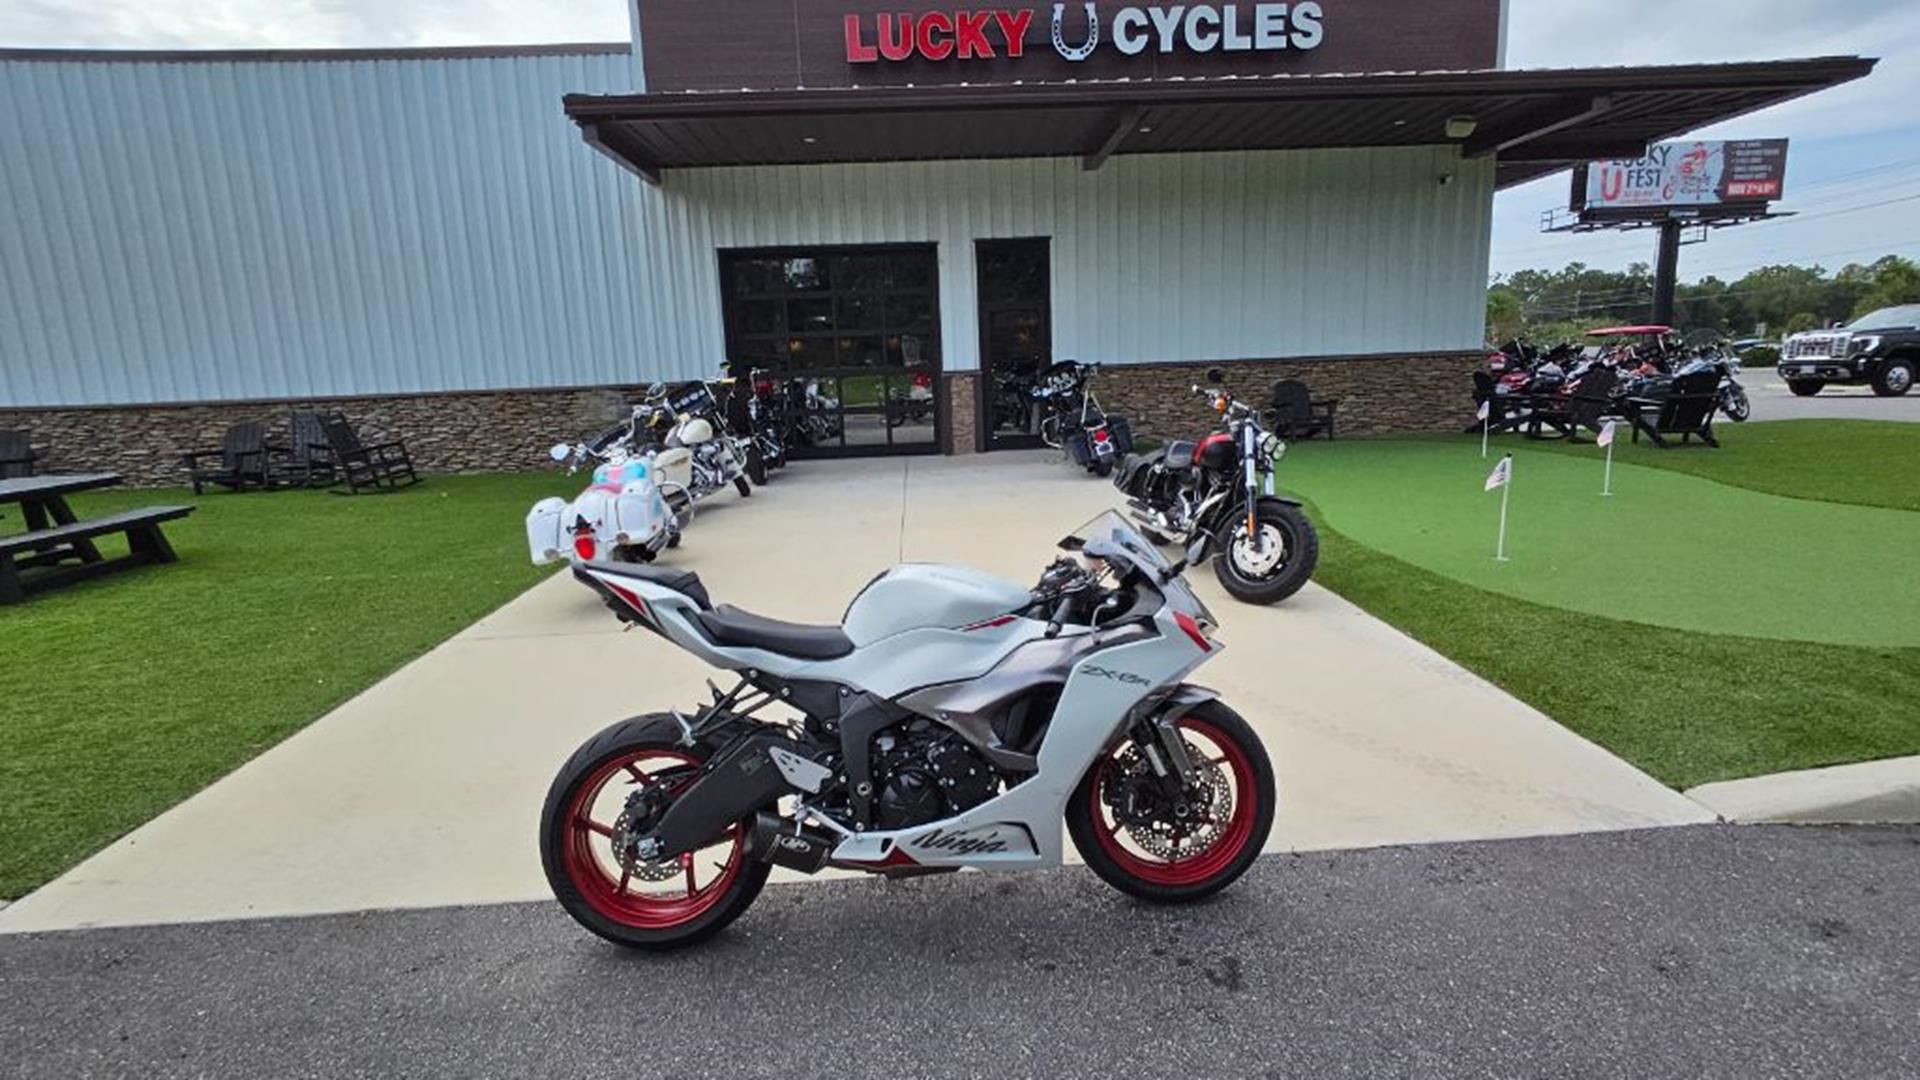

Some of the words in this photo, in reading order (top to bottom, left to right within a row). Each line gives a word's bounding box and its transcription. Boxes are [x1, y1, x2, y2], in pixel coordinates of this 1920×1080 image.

[844, 9, 1034, 62] LUCKY
[1112, 1, 1324, 54] CYCLES
[1626, 168, 1662, 188] FEST
[910, 828, 1008, 857] Ninja
